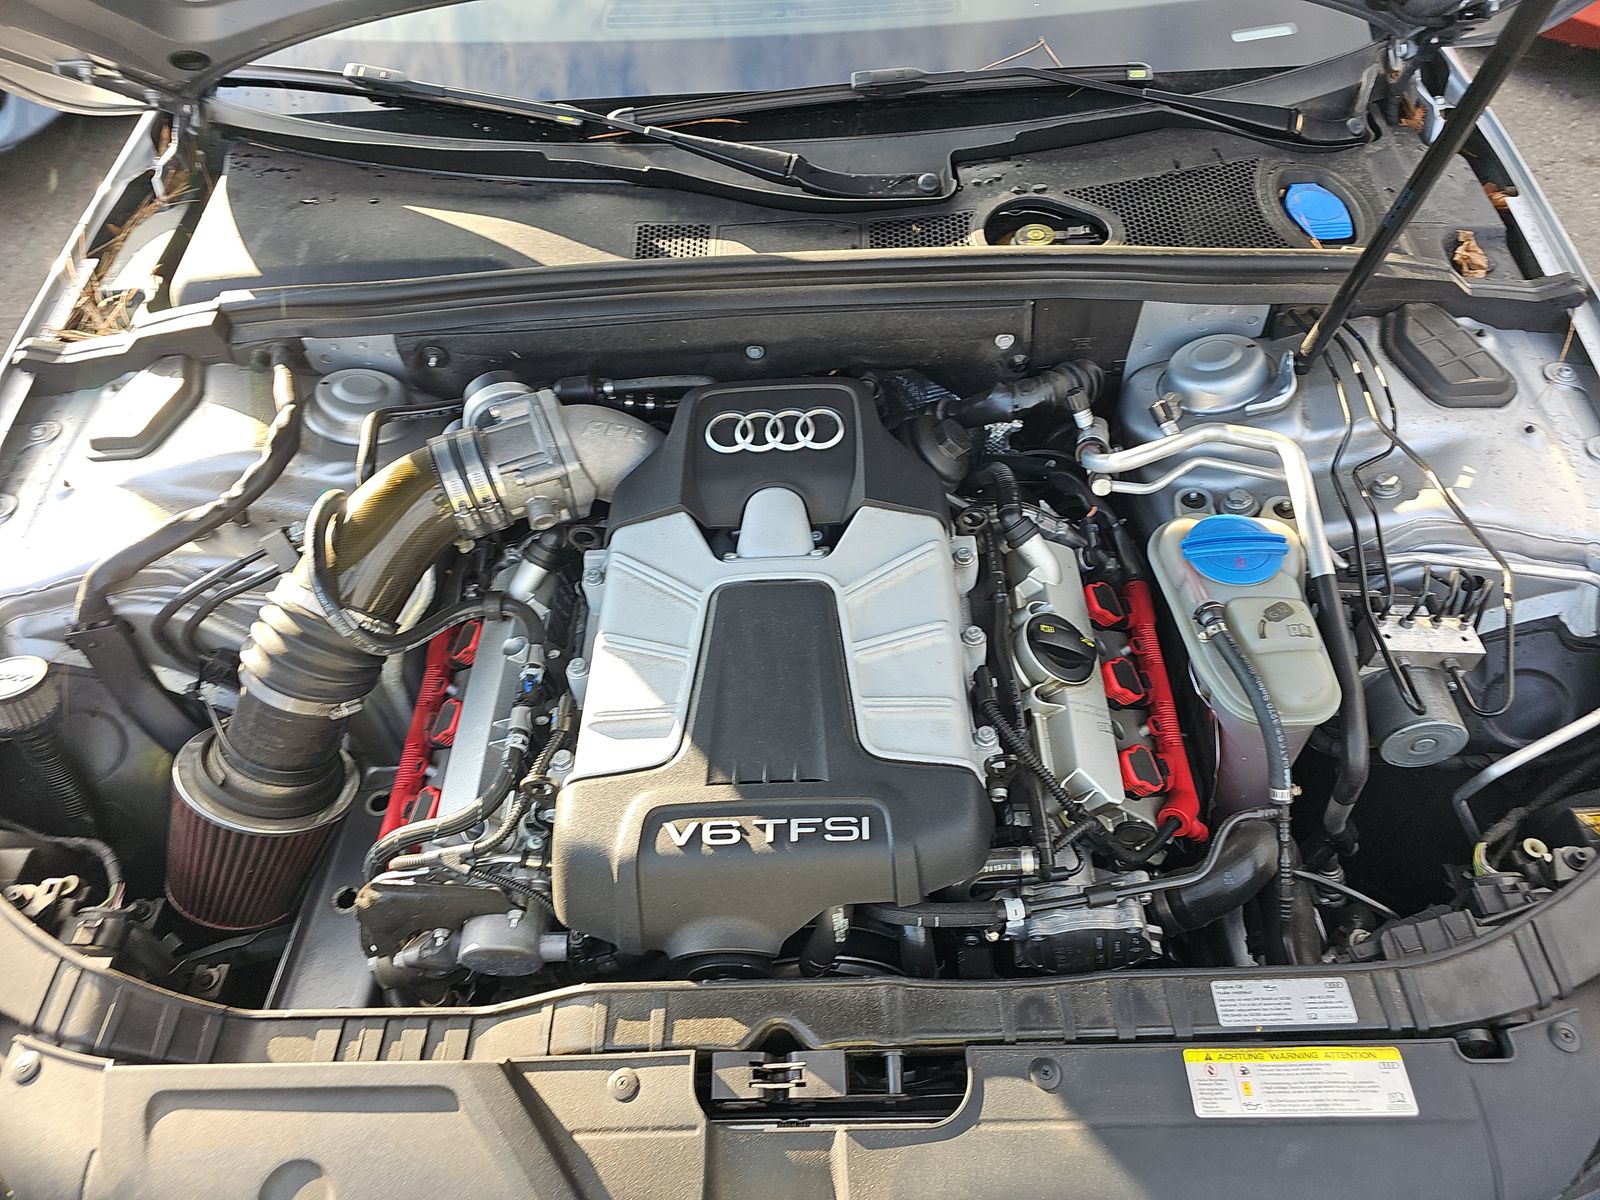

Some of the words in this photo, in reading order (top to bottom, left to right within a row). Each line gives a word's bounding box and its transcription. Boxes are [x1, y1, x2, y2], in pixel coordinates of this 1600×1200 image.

[582, 420, 648, 443] APR
[662, 820, 742, 846] V6
[753, 816, 870, 843] TFSI
[1217, 1052, 1264, 1061] ACHTUNG
[1269, 1052, 1318, 1060] WARNING
[1324, 1051, 1377, 1059] ATTENTION
